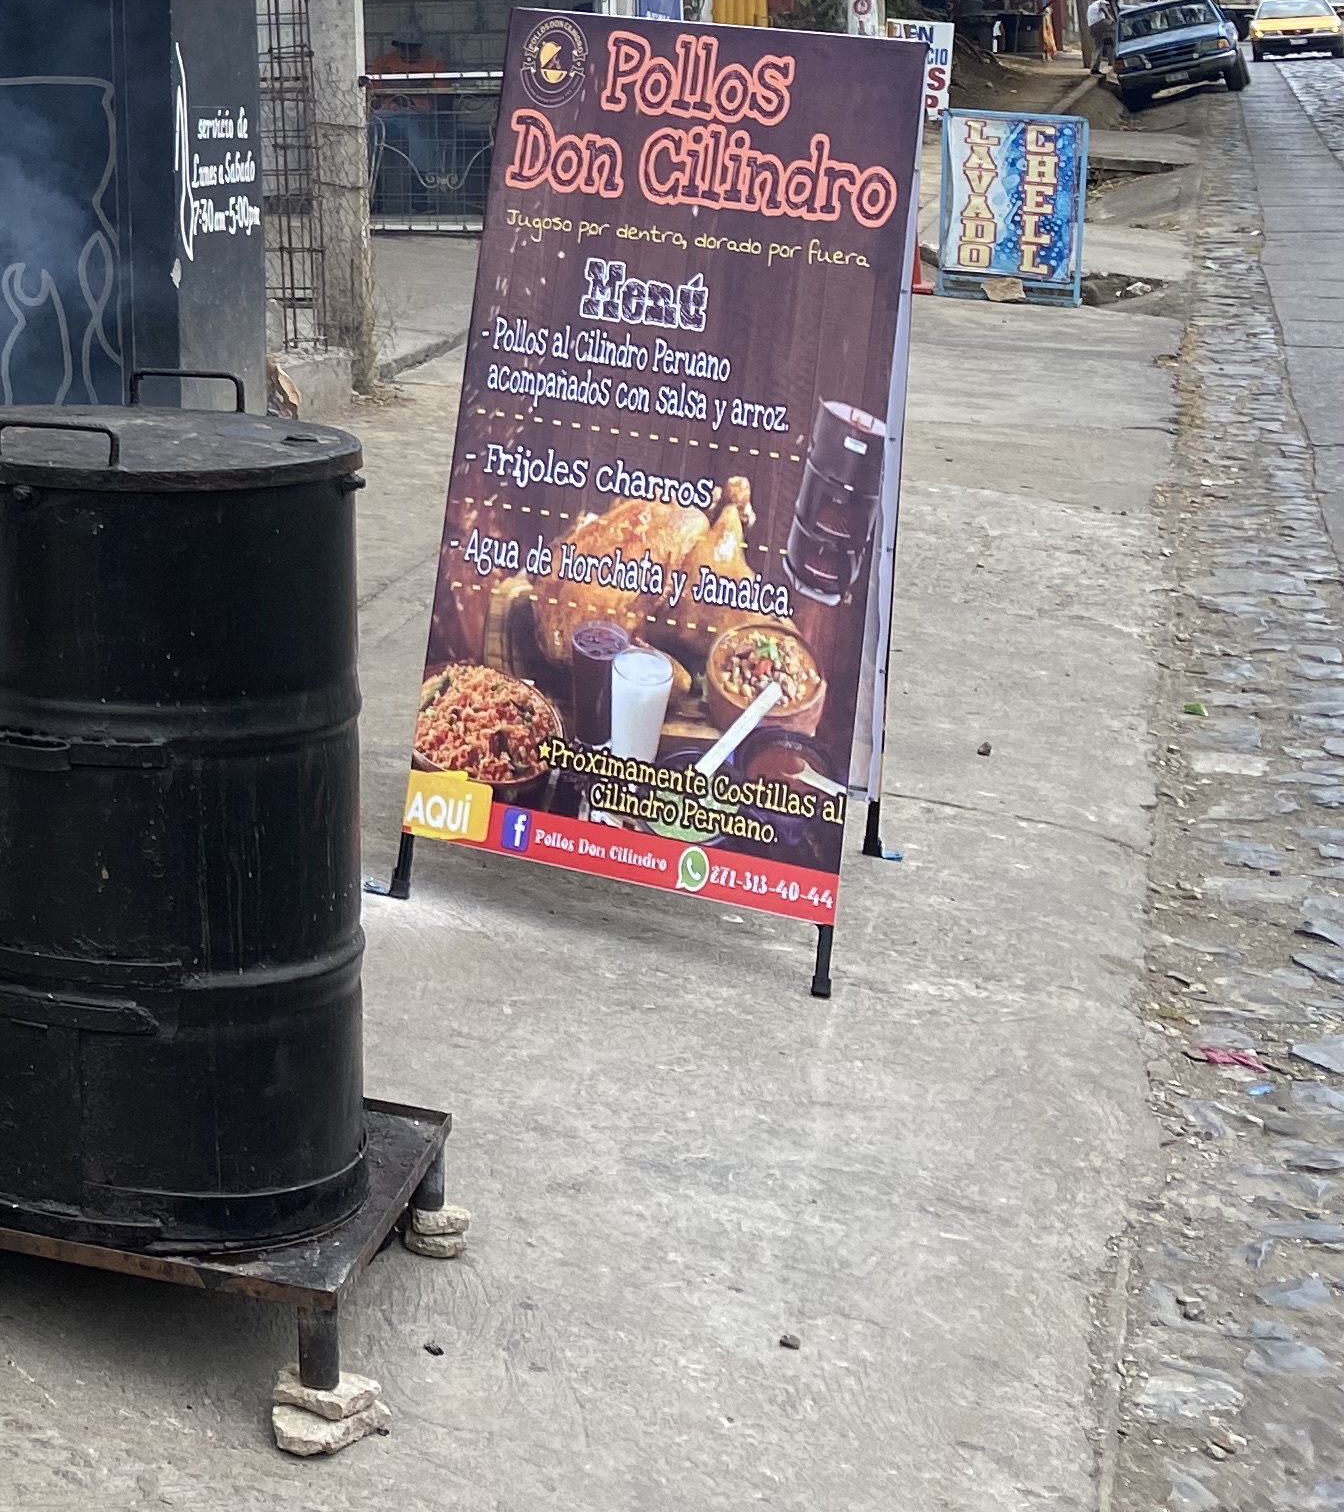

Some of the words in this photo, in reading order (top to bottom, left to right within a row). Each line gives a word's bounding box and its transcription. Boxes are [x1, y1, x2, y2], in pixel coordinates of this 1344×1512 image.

[601, 29, 796, 126] Pollos
[197, 109, 234, 140] servicio
[237, 106, 248, 139] de
[505, 108, 624, 198] Don
[639, 124, 898, 228] Cilindro
[506, 209, 573, 242] Jugoso
[578, 221, 610, 243] por
[616, 225, 688, 250] dentro,
[695, 234, 762, 256] dorado
[767, 244, 802, 266] por
[807, 239, 871, 268] fuera
[580, 257, 709, 333] Menú
[493, 316, 548, 352] Pollos
[552, 326, 570, 358] al
[574, 328, 649, 371] Cilindro
[652, 339, 732, 382] Peruano
[487, 363, 612, 410] acompañados
[615, 382, 650, 413] con
[655, 386, 708, 422] salsa
[712, 400, 728, 431] y
[731, 403, 790, 432] arroz.
[483, 444, 590, 490] Frijoles
[595, 461, 714, 509] charros
[464, 528, 520, 577] Agua
[526, 535, 552, 572] de
[560, 544, 665, 596] Horchata
[669, 570, 689, 606] y
[692, 566, 795, 617] Jamaica.
[590, 783, 678, 824] Cilindro
[681, 798, 779, 844] Peruano.
[712, 775, 818, 819] Costillas
[822, 791, 845, 825] al
[535, 829, 575, 853] Pollos
[578, 837, 606, 859] Don
[609, 844, 668, 872] Cilindro
[710, 866, 834, 909] 271-313-40-44
